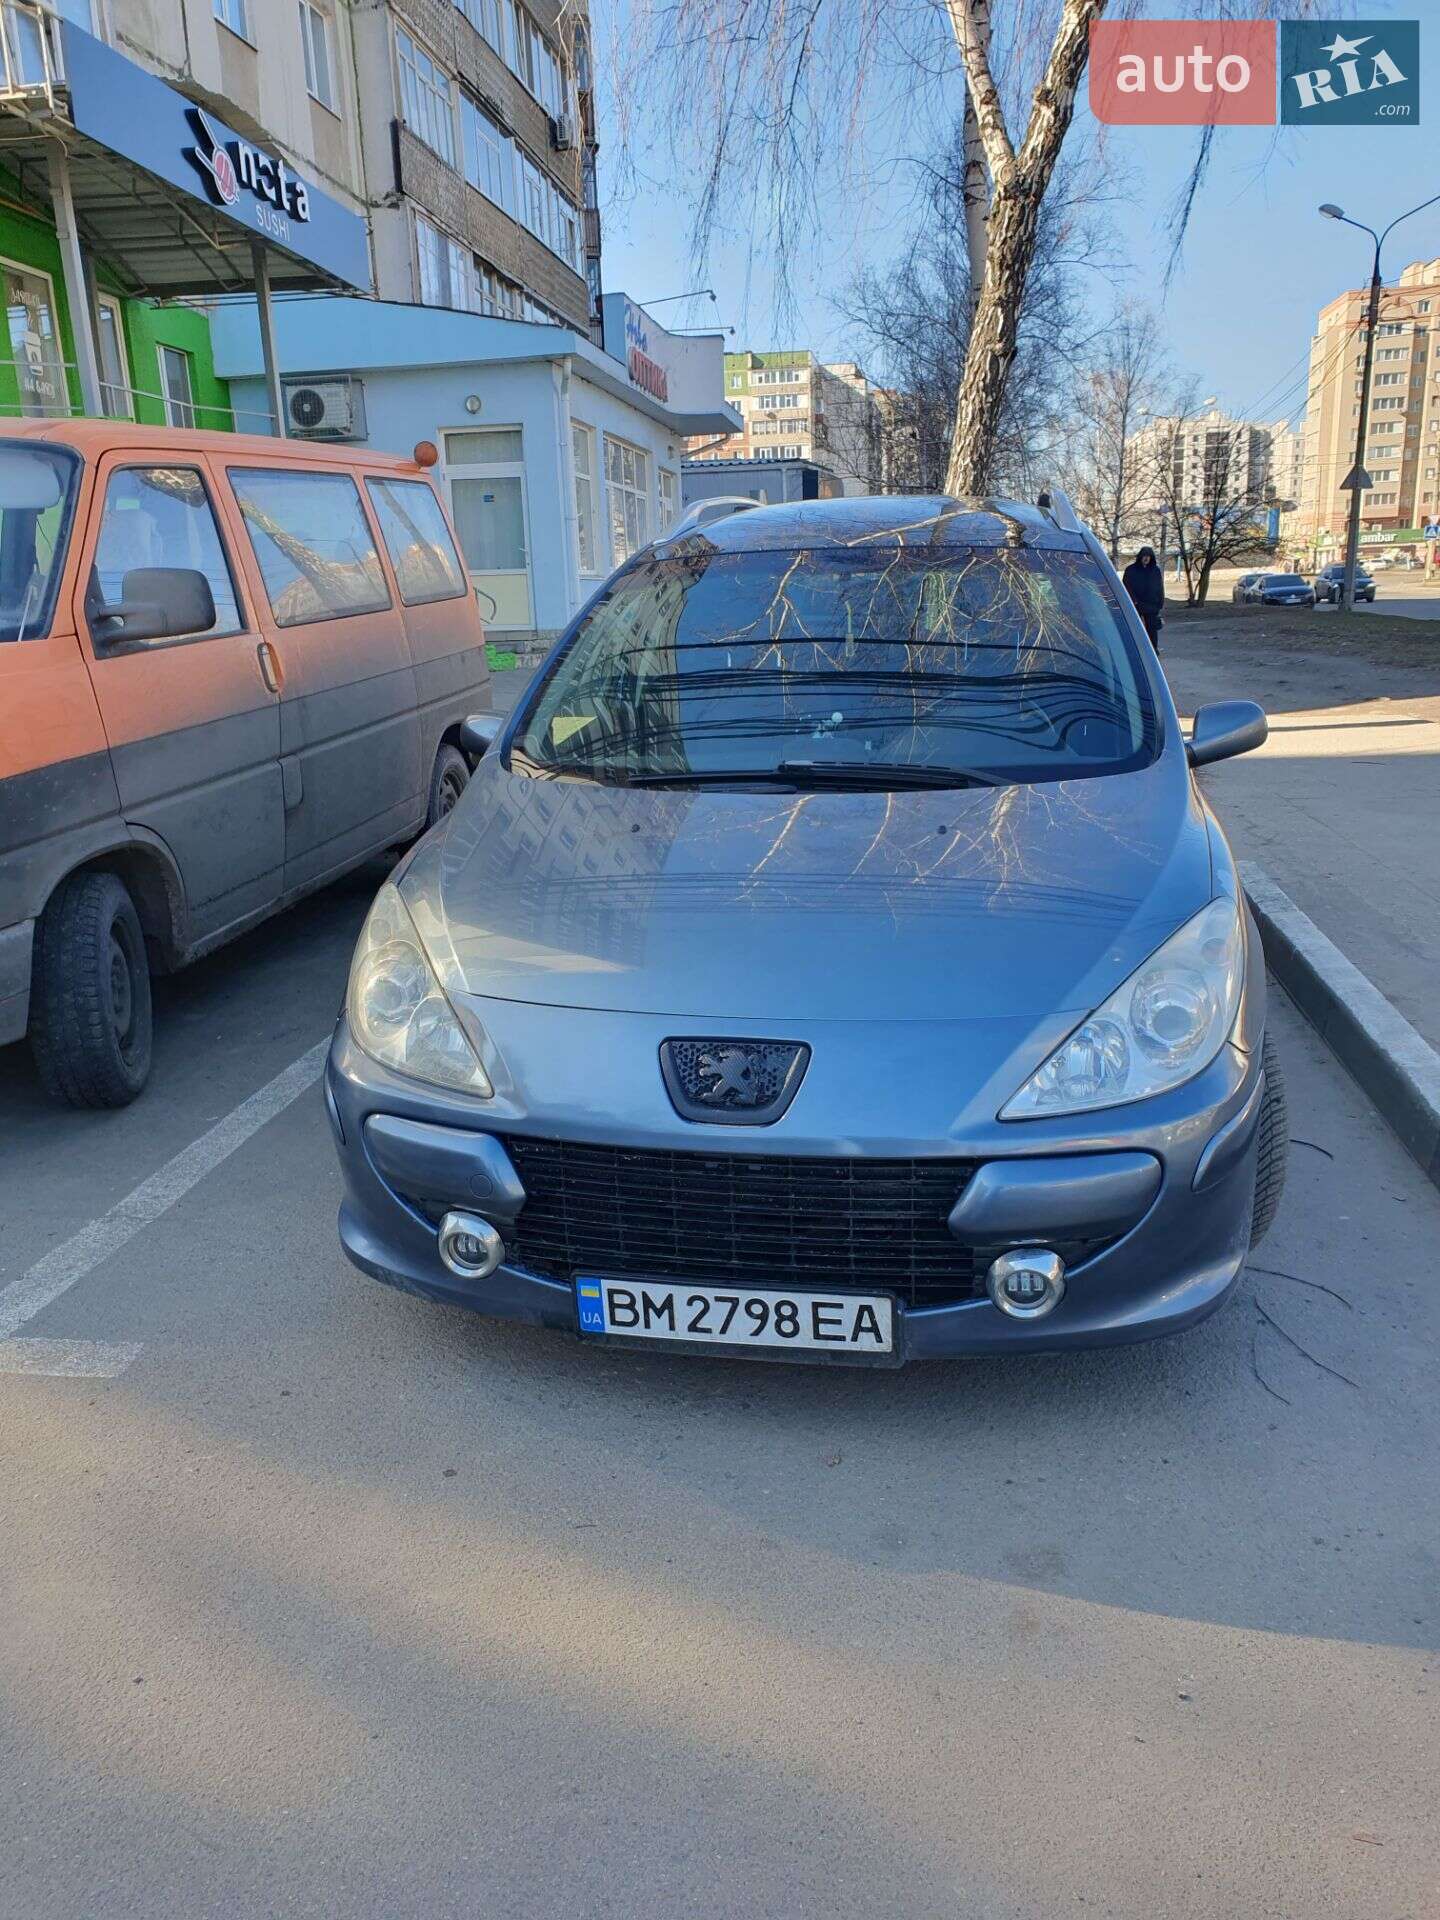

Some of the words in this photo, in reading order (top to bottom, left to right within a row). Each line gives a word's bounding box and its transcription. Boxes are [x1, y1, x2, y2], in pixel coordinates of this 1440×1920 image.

[255, 204, 291, 242] SUSHI
[1360, 532, 1398, 543] ambar
[582, 1312, 602, 1325] UA
[606, 1288, 677, 1332] BM
[686, 1295, 801, 1338] 2798
[811, 1301, 883, 1344] EA
